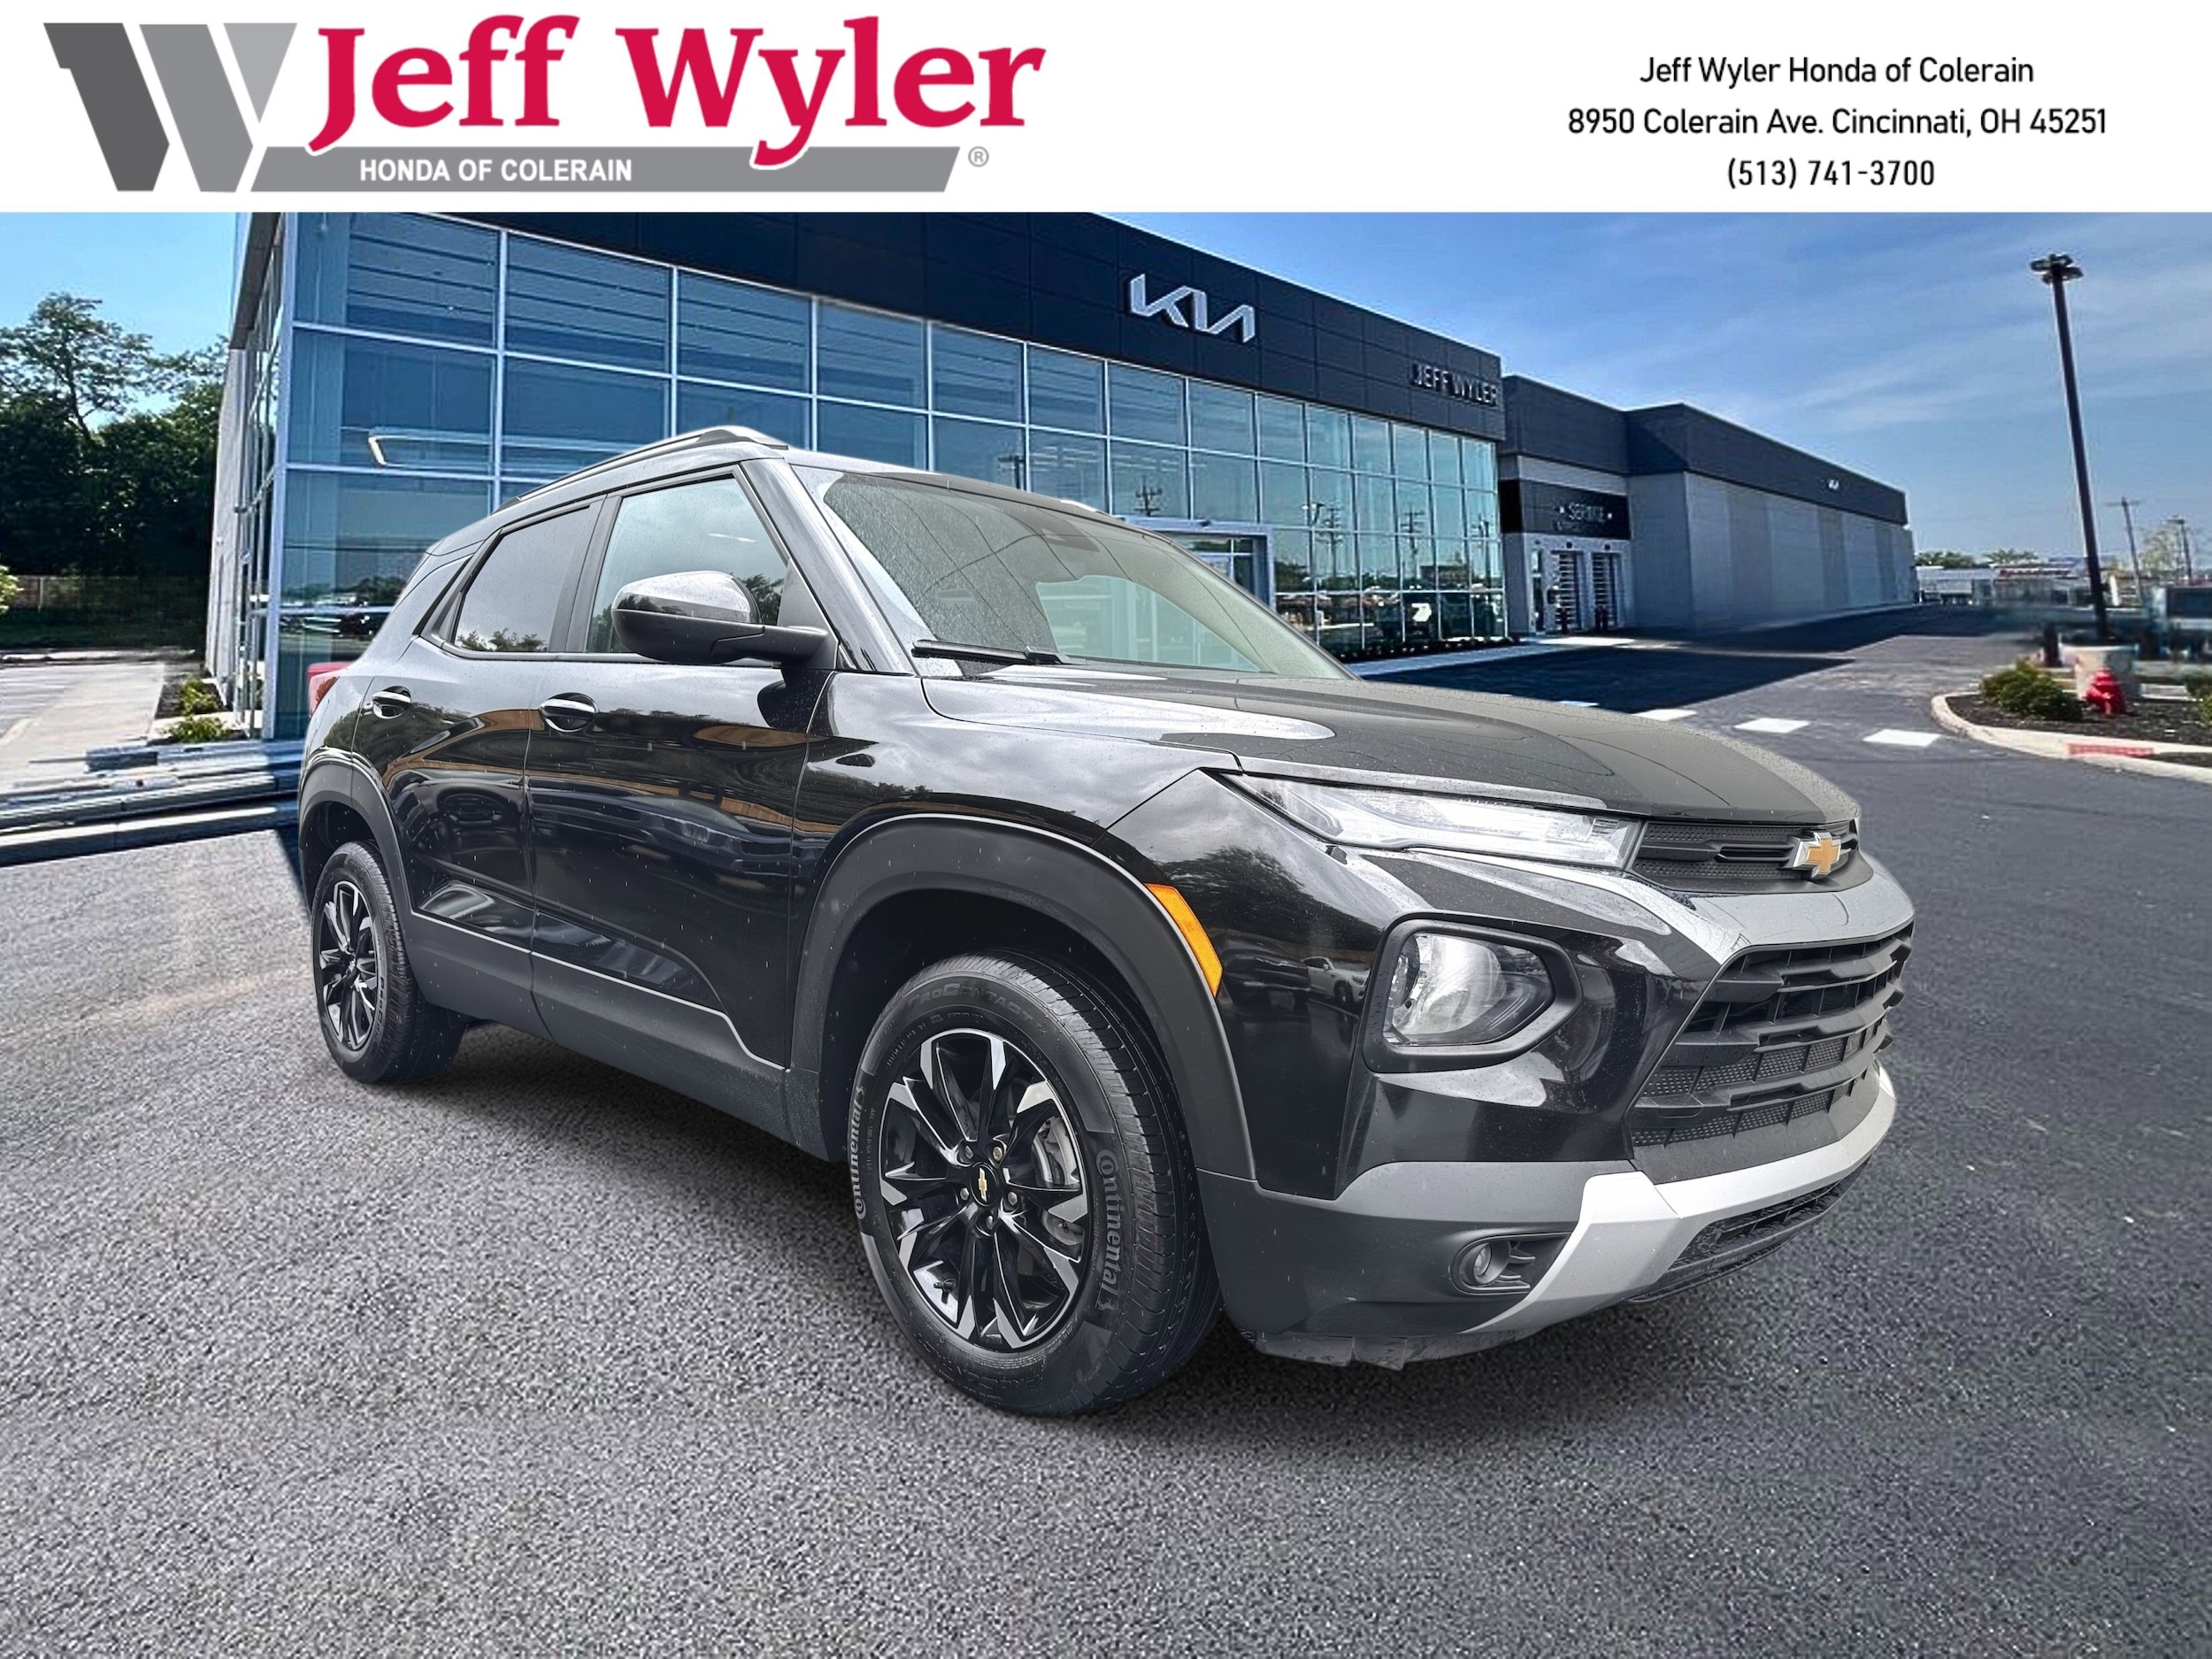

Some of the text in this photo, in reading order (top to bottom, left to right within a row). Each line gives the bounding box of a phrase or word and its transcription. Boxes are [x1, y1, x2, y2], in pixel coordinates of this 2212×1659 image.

[1130, 273, 1256, 343] KIA
[1412, 361, 1501, 408] JEFF WYLER
[850, 1097, 867, 1220] Continental
[1095, 1149, 1125, 1295] Continental
